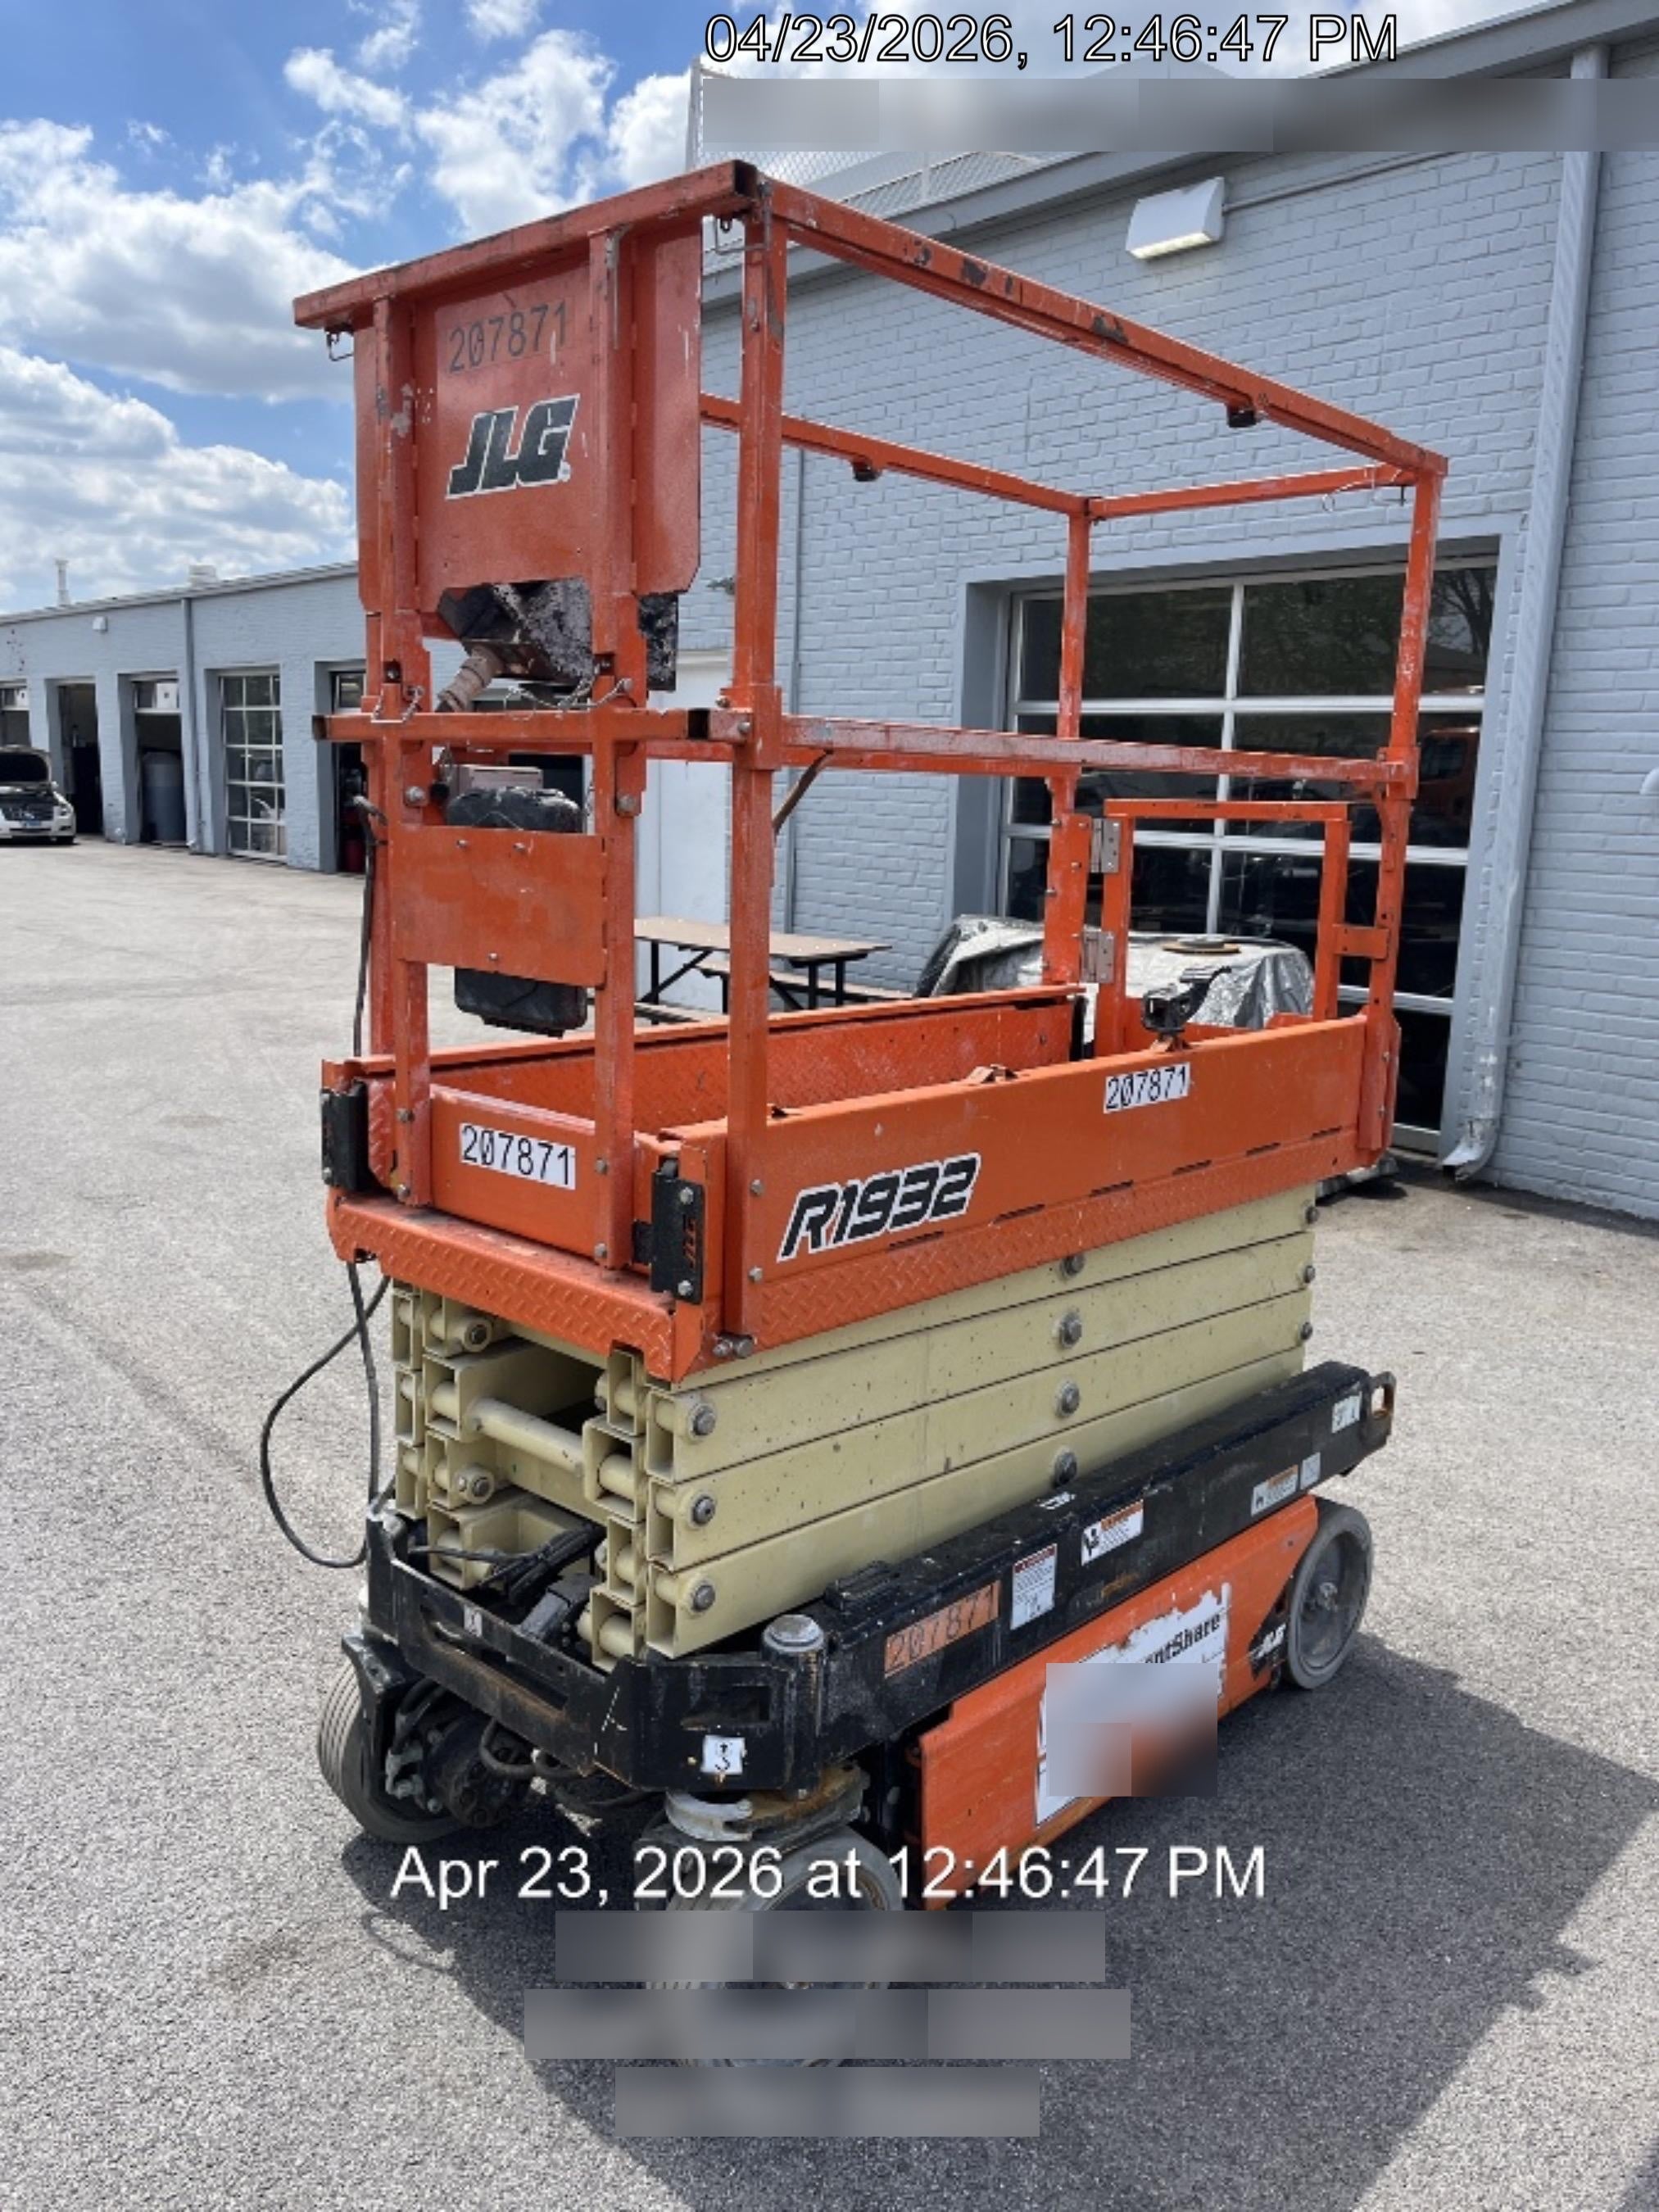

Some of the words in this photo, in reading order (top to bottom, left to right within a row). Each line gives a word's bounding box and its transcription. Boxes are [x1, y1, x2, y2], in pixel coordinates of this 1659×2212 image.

[449, 300, 567, 373] 207871
[446, 394, 580, 500] JLG
[1107, 1066, 1185, 1109] 207871
[462, 1125, 569, 1185] 207871
[777, 1152, 981, 1262] R1932
